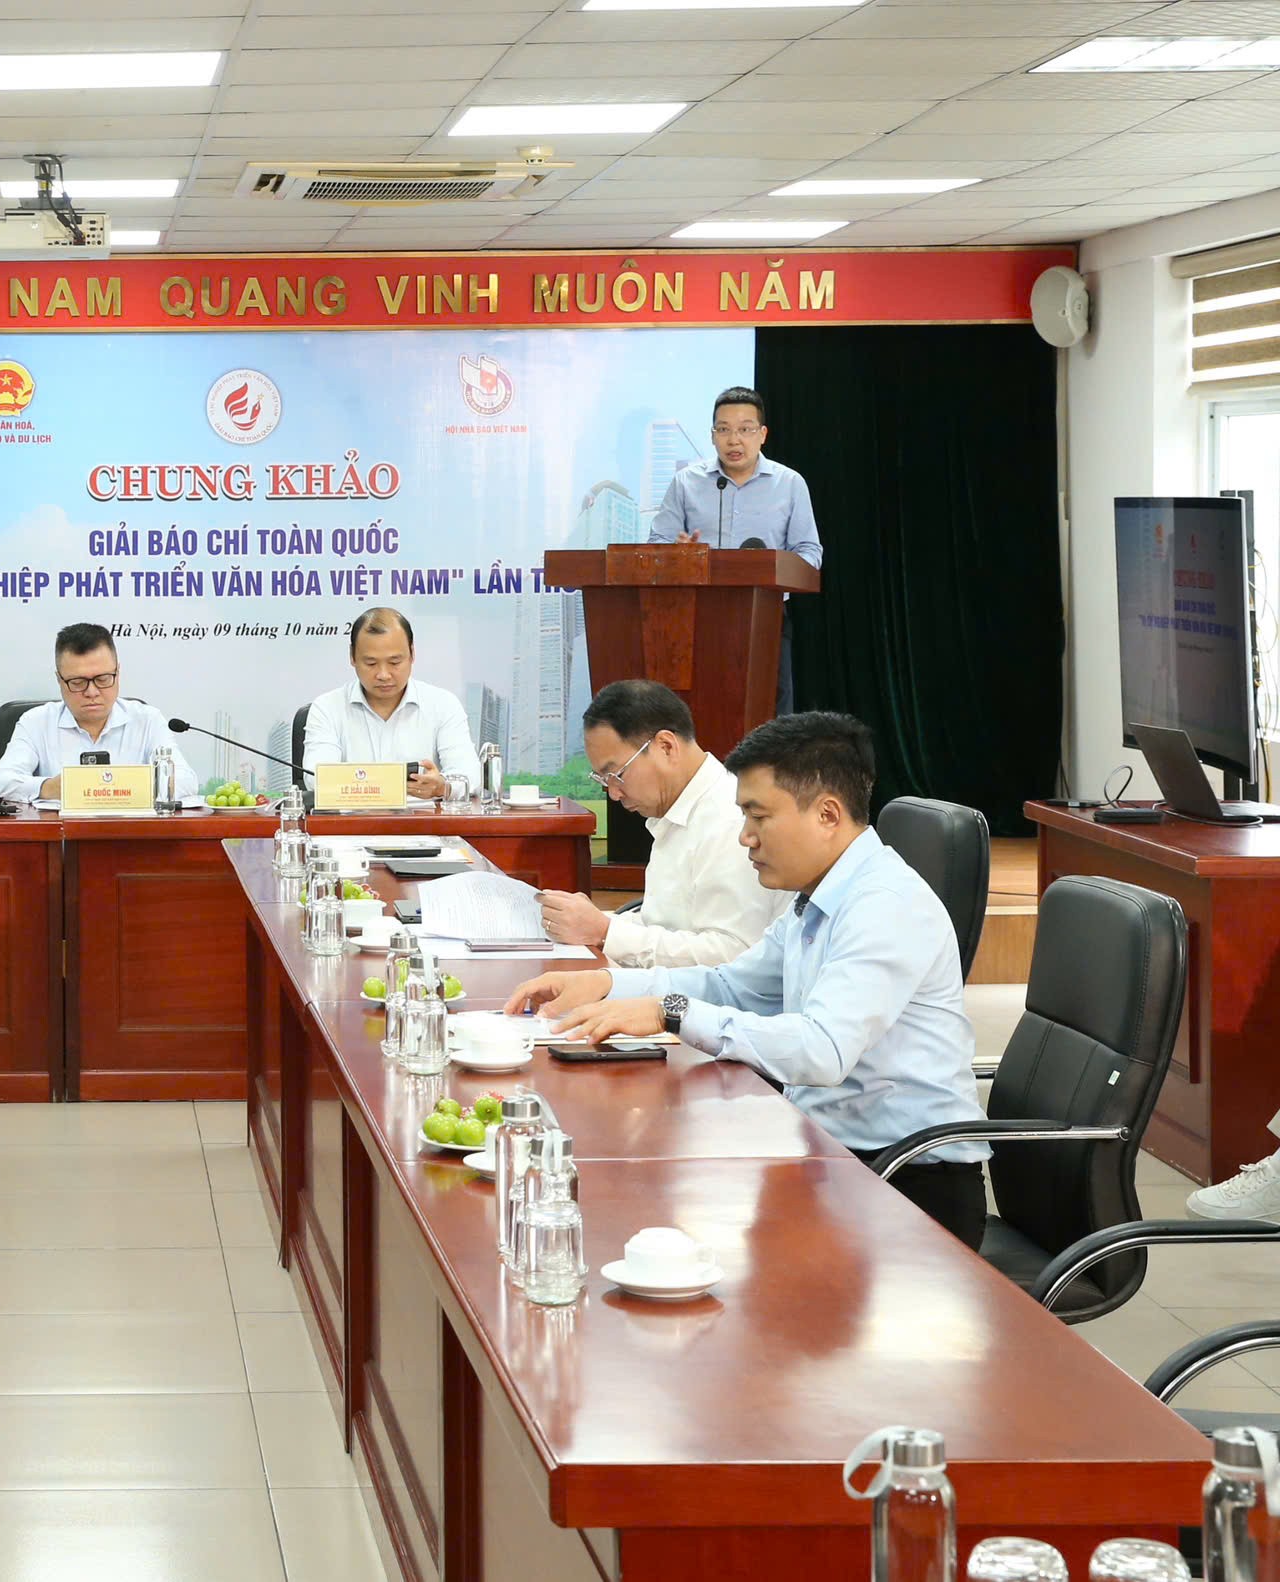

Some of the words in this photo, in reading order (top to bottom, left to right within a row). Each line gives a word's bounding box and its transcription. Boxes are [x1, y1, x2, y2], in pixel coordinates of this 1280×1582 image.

[9, 277, 121, 317] NAM
[160, 275, 346, 319] QUANG
[376, 274, 498, 314] VINH
[533, 258, 684, 313] MUÔN
[720, 258, 835, 310] NĂM
[4, 433, 16, 443] VÀ
[18, 435, 30, 443] DU
[32, 435, 51, 445] LỊCH
[87, 463, 256, 501] CHUNG
[266, 449, 400, 500] KHẢO
[89, 522, 139, 556] GIẢI
[148, 524, 198, 556] BÁO
[207, 524, 248, 555] CHÍ
[257, 523, 322, 555] TOÀN
[331, 519, 399, 557] QUỐC
[59, 567, 123, 597] PHÁT
[131, 560, 203, 597] TRIỂN
[212, 566, 262, 596] VĂN
[272, 565, 320, 596] HÓA
[329, 564, 382, 601] VIỆT
[391, 567, 464, 595] NAM"
[474, 559, 522, 594] LẦN
[110, 623, 132, 637] Hà
[136, 623, 168, 640] Nội,
[172, 624, 209, 640] ngày
[213, 623, 232, 637] 09
[235, 622, 278, 640] tháng
[284, 622, 301, 636] 10
[305, 623, 338, 636] năm
